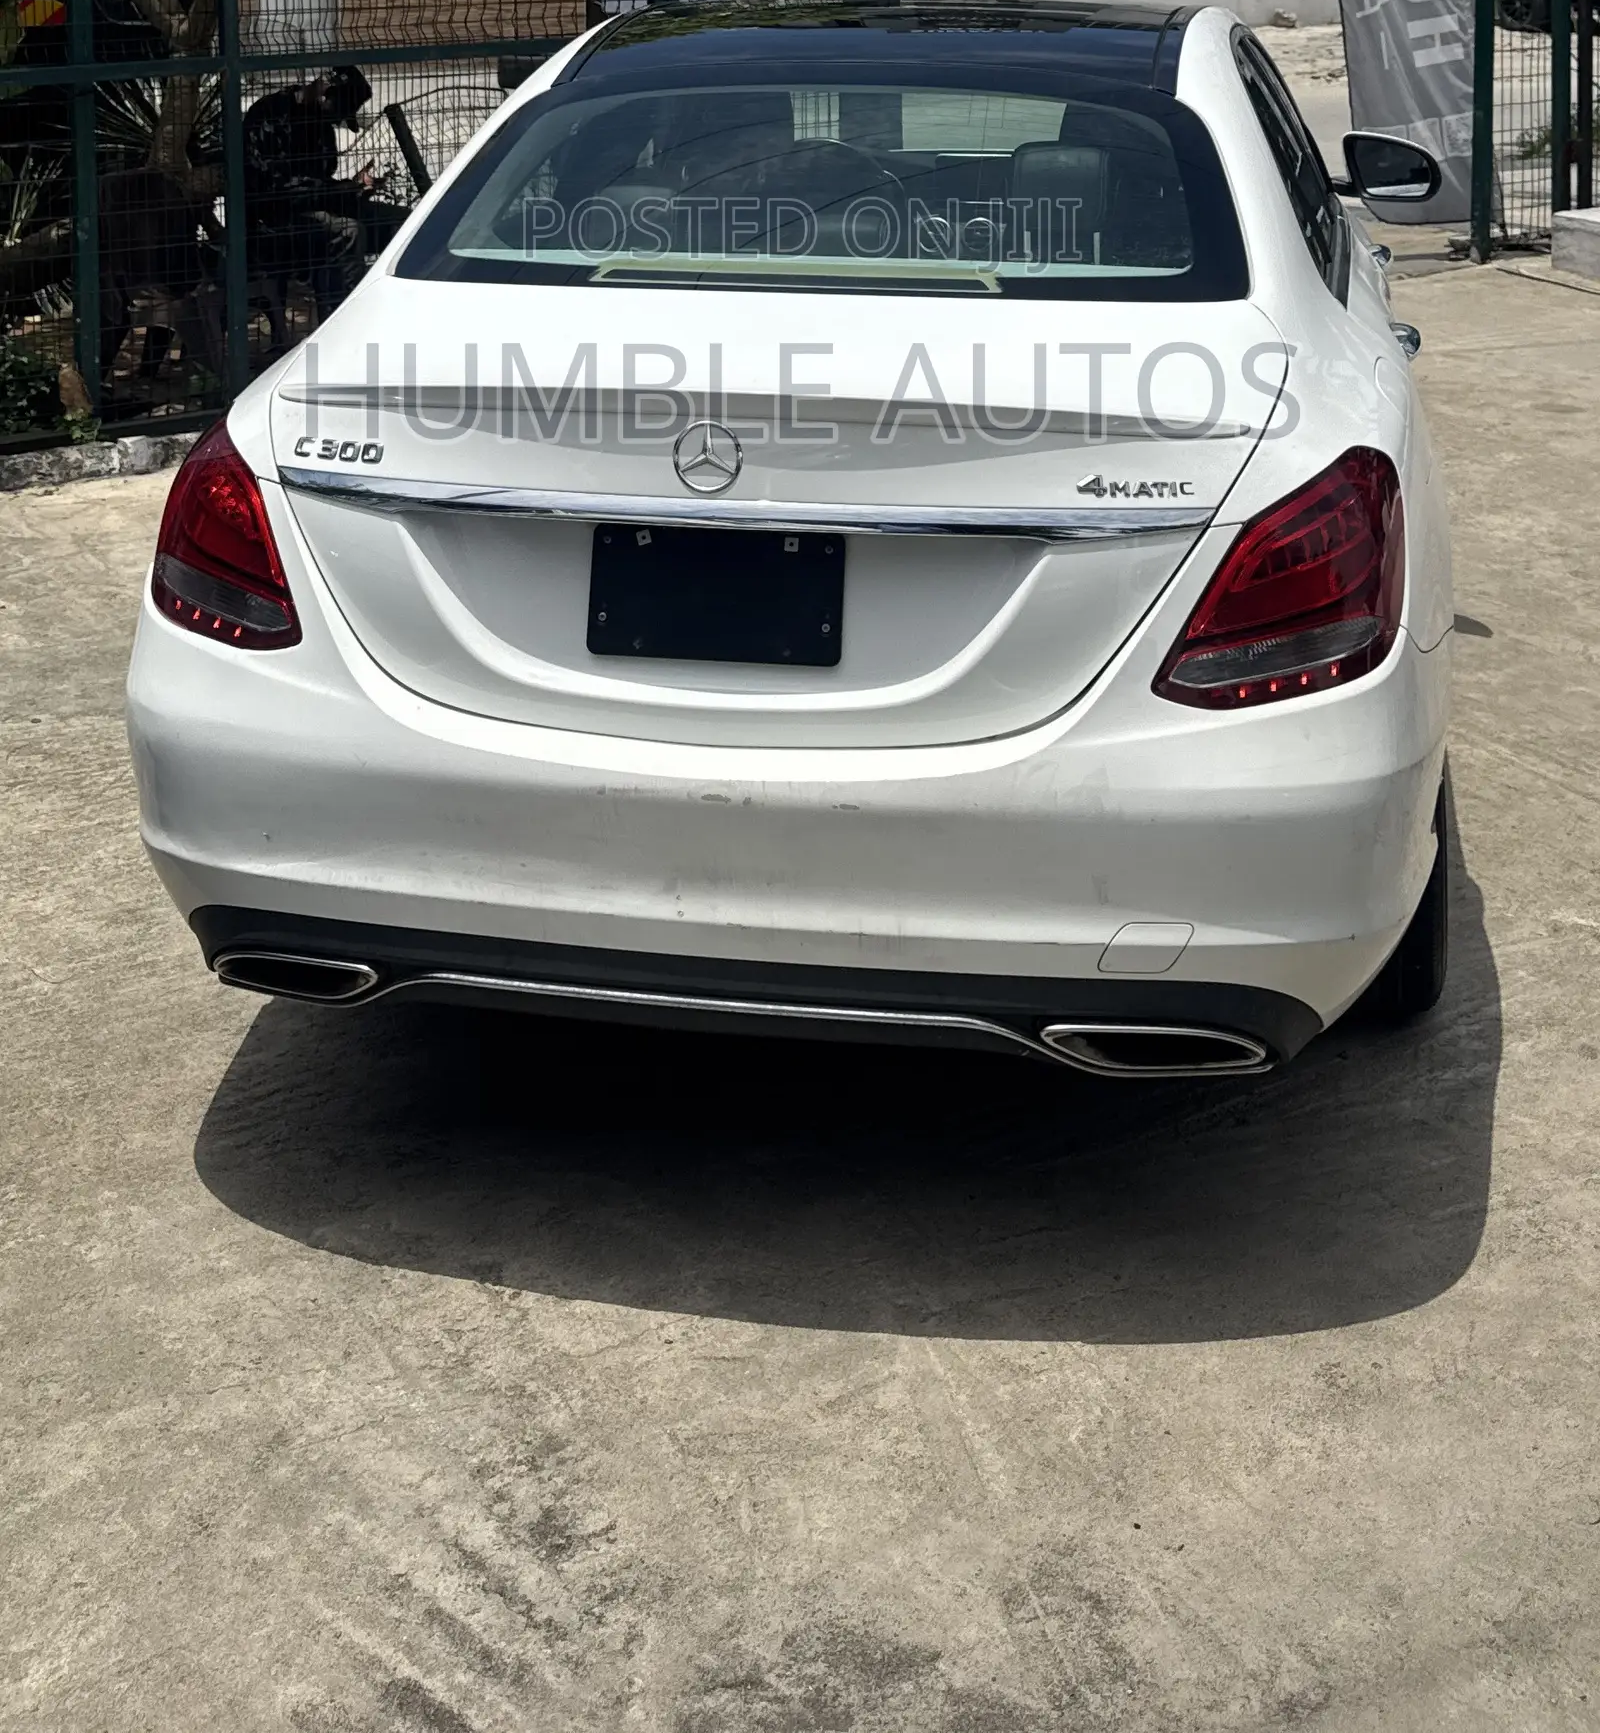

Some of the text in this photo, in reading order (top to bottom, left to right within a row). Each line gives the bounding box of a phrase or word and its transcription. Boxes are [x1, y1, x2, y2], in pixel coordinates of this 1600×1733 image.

[294, 436, 385, 464] C 300
[1076, 474, 1195, 498] 4MATIC
